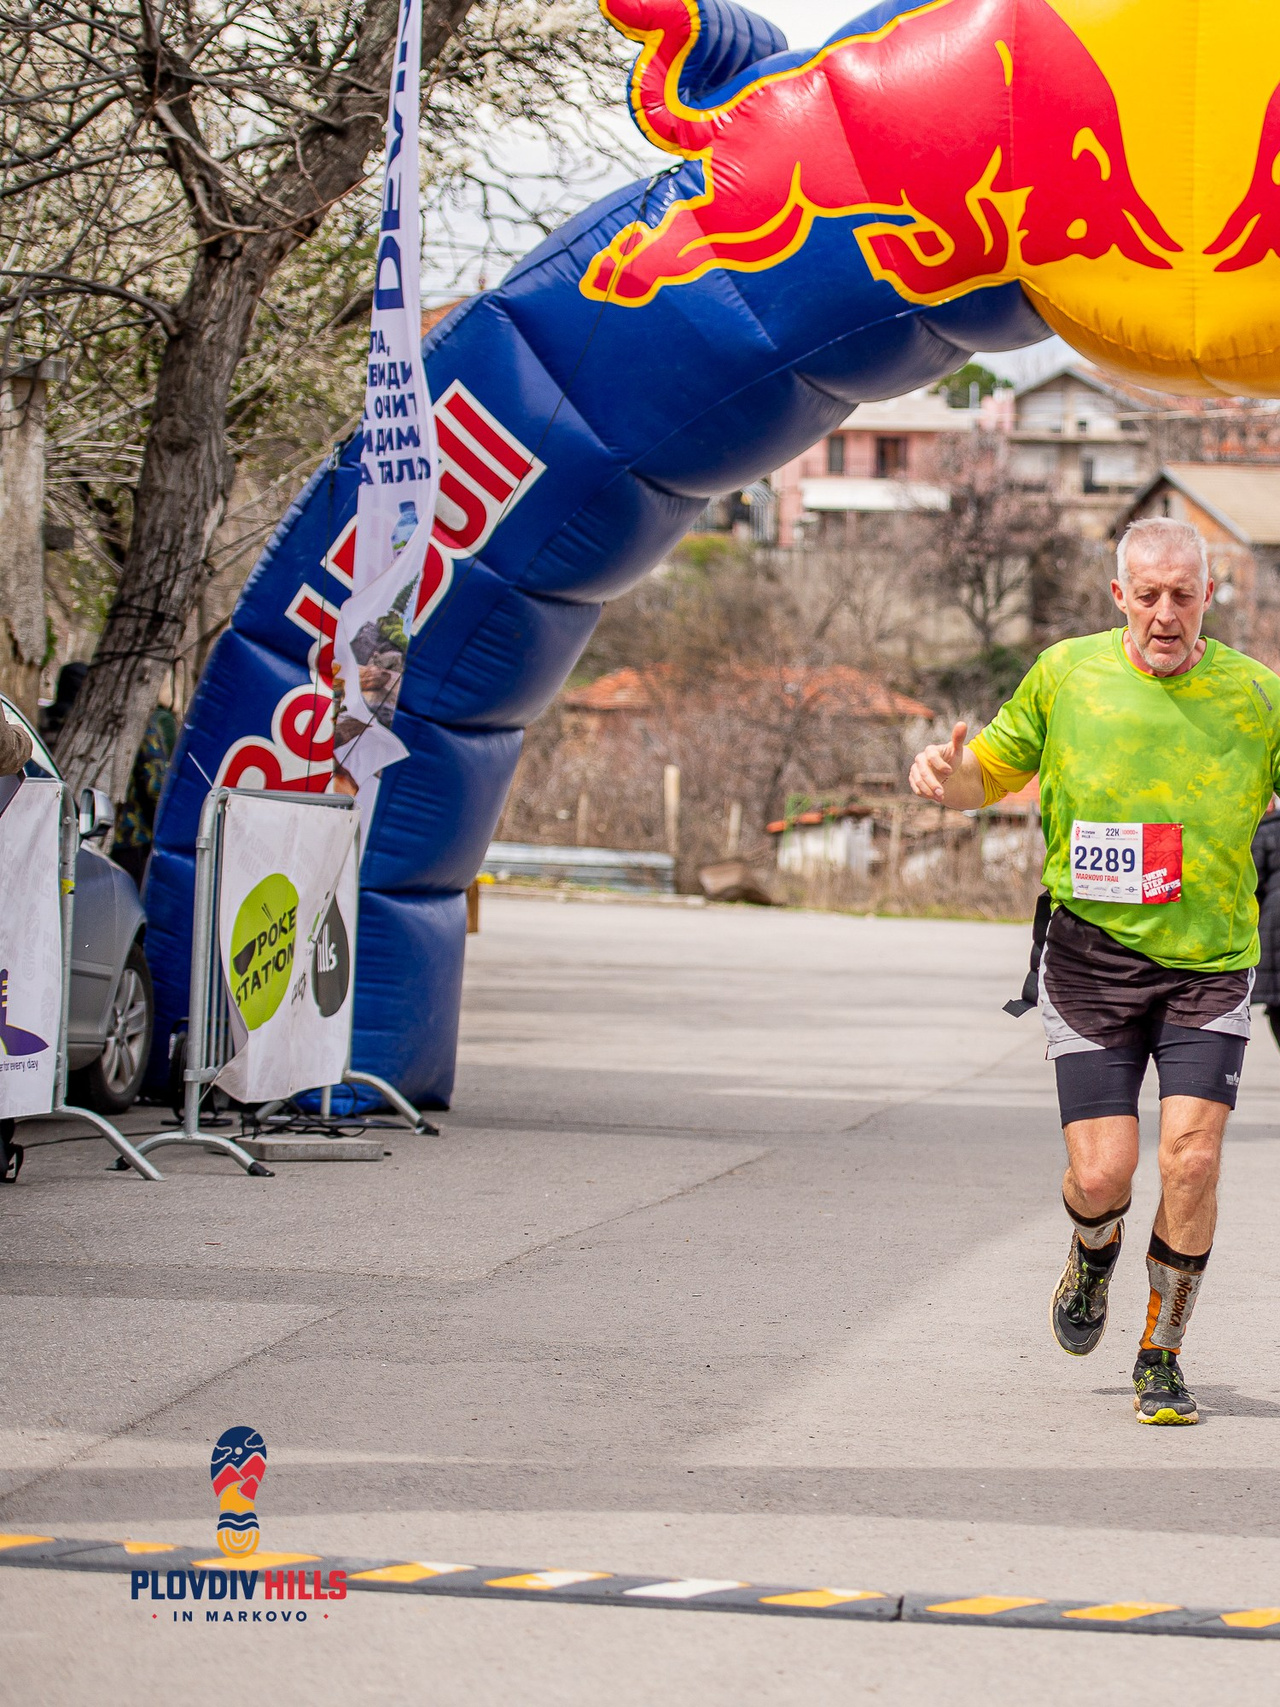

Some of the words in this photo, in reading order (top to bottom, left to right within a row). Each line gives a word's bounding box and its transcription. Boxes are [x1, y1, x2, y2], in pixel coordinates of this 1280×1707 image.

[1105, 827, 1120, 837] 22K
[1074, 845, 1136, 872] 2289
[1075, 872, 1103, 882] MARKOVO
[1104, 873, 1119, 883] TRAIL
[1142, 878, 1164, 891] STEP
[256, 905, 297, 957] POKE
[235, 938, 295, 1008] STATION
[26, 1058, 39, 1071] day
[1169, 1278, 1193, 1327] NORDICA
